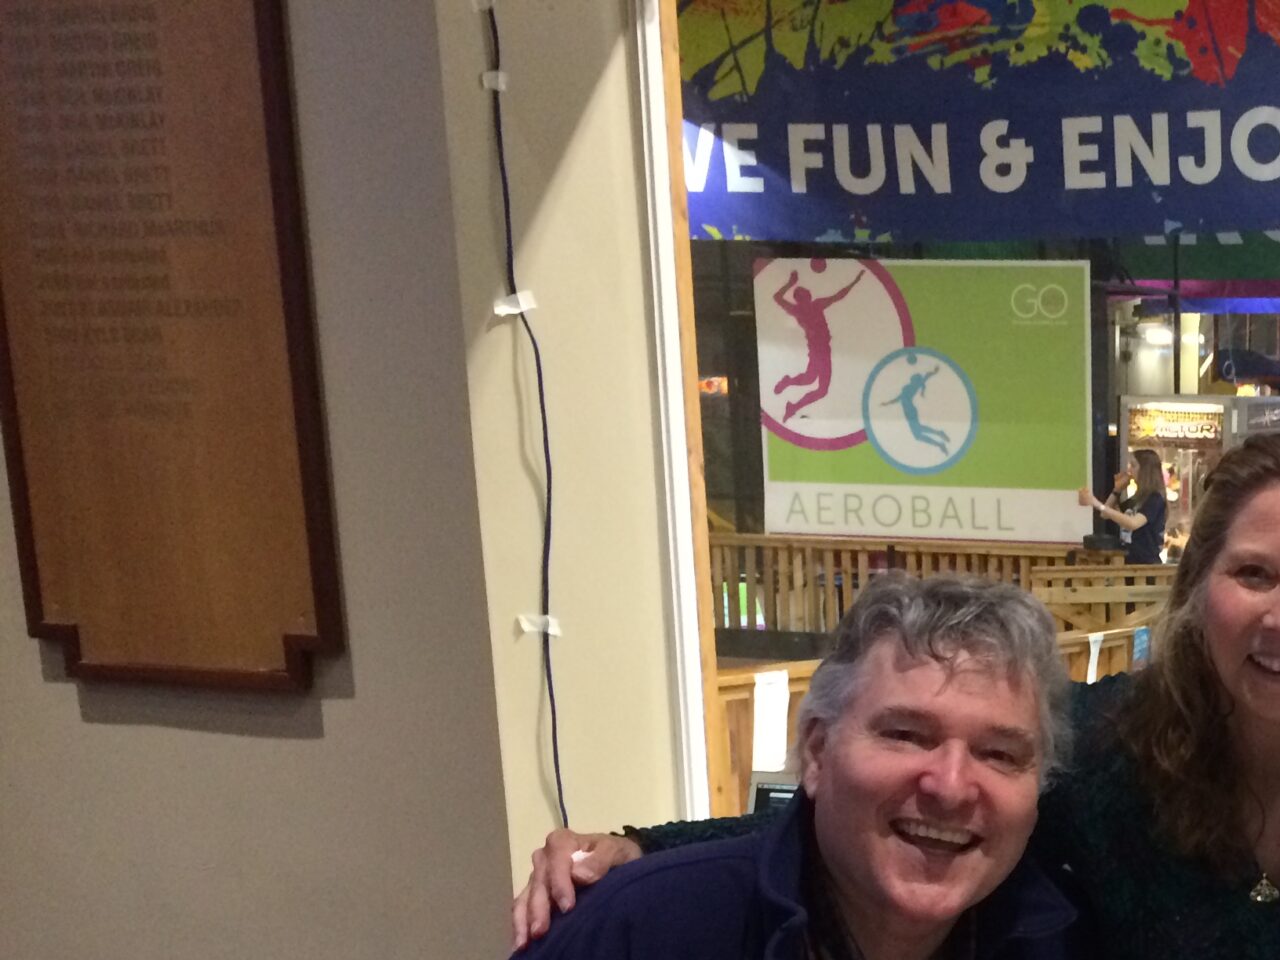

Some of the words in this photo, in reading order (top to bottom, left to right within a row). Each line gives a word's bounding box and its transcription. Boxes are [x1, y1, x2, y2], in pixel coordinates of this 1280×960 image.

[788, 123, 952, 195] FUN
[980, 118, 1034, 194] &
[1011, 283, 1069, 318] GO
[785, 492, 1015, 532] AEROBALL
